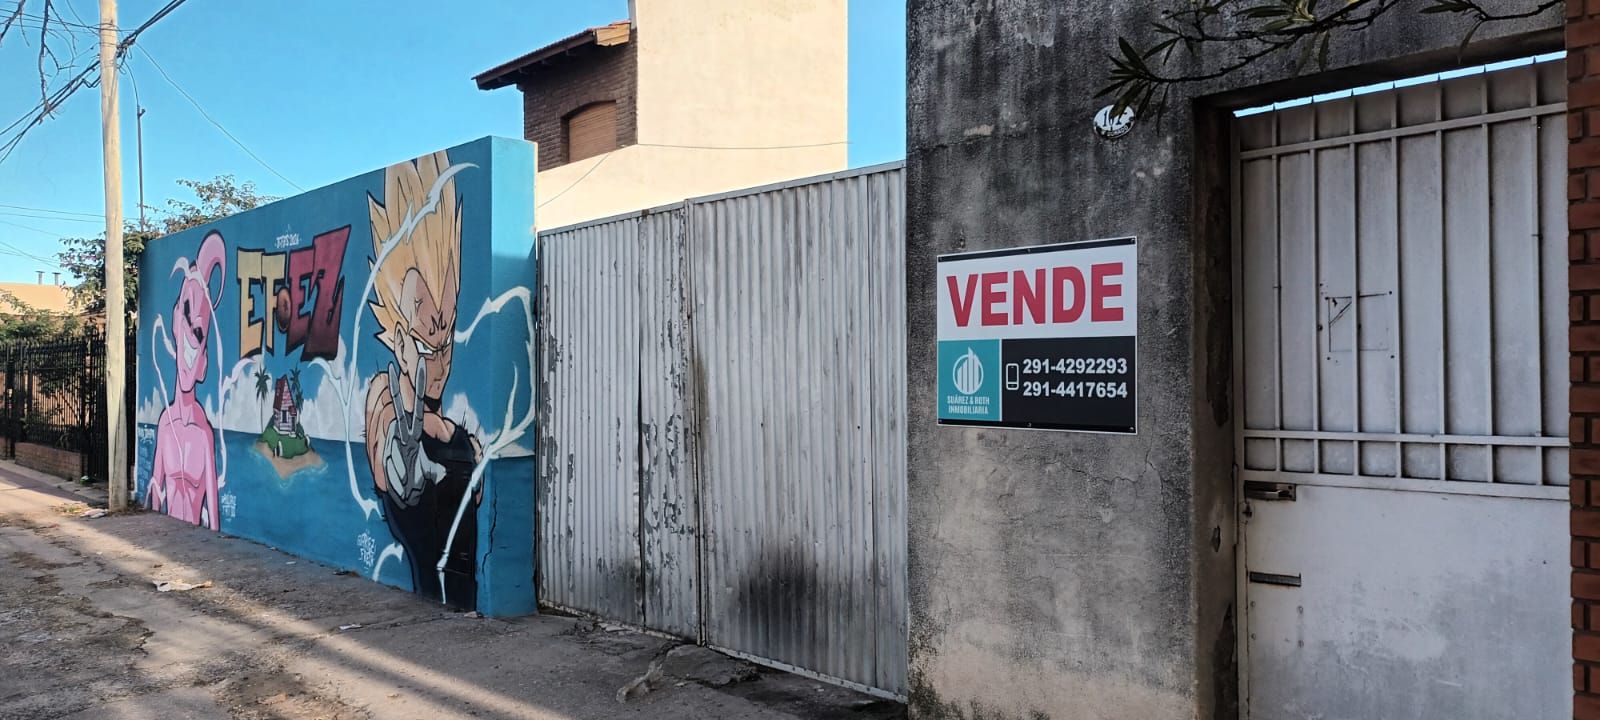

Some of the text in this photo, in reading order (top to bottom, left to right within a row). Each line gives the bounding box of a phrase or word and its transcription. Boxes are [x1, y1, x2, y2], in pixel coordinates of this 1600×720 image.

[946, 262, 1124, 328] VENDE
[1022, 357, 1128, 375] 291-4292293
[1022, 381, 1128, 398] 291-4417654
[974, 396, 990, 405] ROTH
[948, 405, 989, 415] INMOBILIARIA
